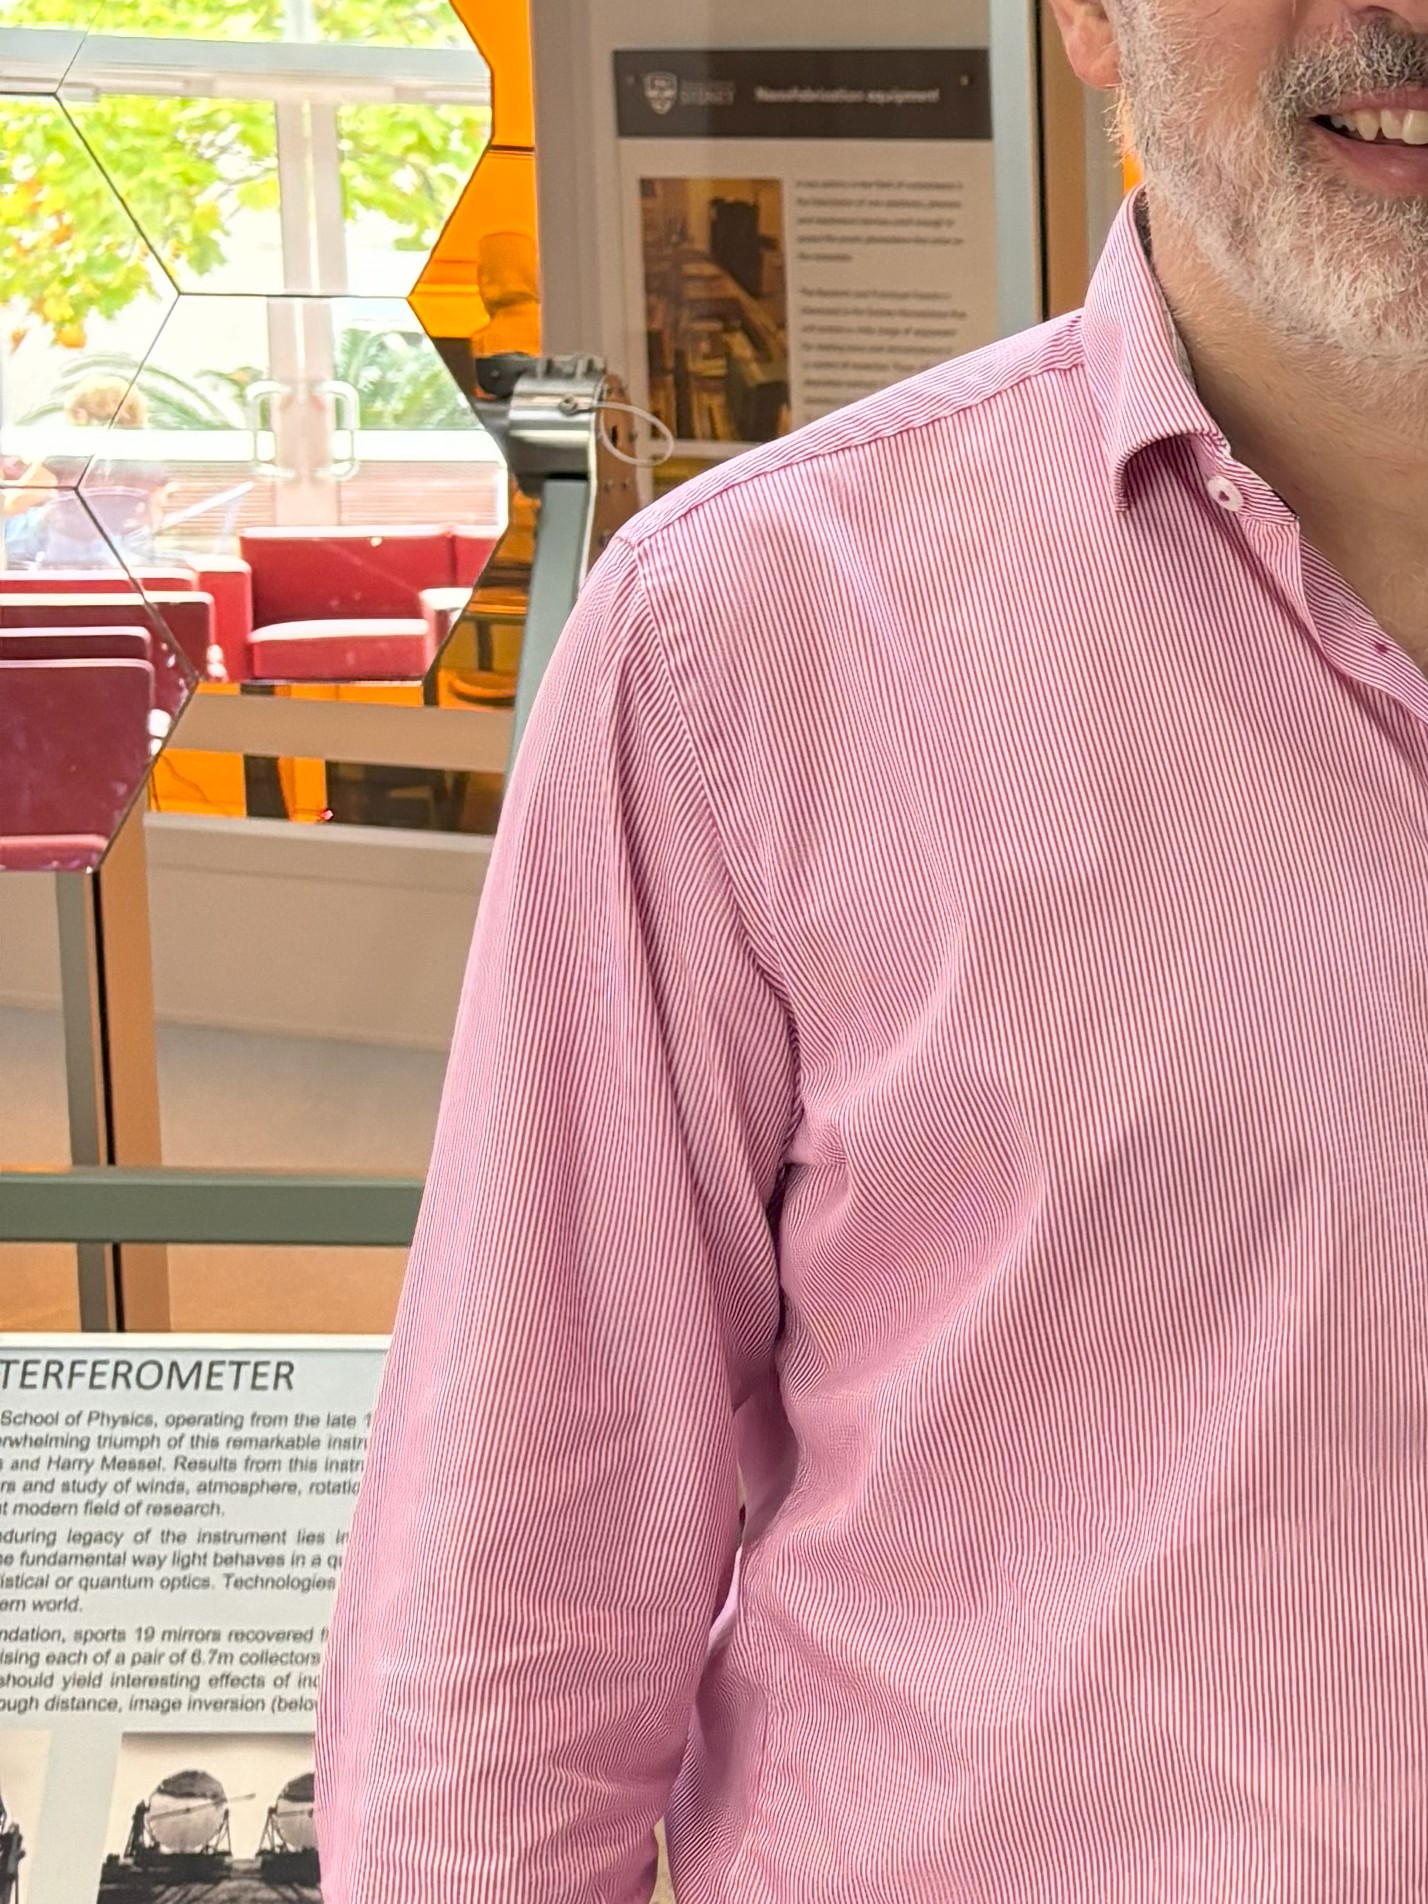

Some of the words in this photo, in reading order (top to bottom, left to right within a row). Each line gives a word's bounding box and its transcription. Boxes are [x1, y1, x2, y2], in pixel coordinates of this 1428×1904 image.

[0, 1359, 295, 1391] TERFEROMETER
[0, 1410, 60, 1426] School
[65, 1410, 83, 1426] of
[87, 1410, 158, 1432] Physics,
[164, 1411, 244, 1432] operating
[250, 1411, 288, 1428] from
[294, 1412, 321, 1428] the
[326, 1412, 357, 1428] late
[0, 1432, 91, 1454] rwhelming
[96, 1432, 161, 1454] triumph
[167, 1433, 186, 1449] of
[190, 1433, 220, 1449] this
[226, 1433, 321, 1450] remarkable
[10, 1455, 41, 1471] and
[47, 1455, 95, 1476] Harry
[100, 1456, 166, 1472] Messel.
[173, 1456, 237, 1472] Results
[244, 1457, 282, 1472] from
[288, 1457, 318, 1472] this
[22, 1478, 55, 1494] and
[60, 1478, 108, 1499] study
[113, 1478, 132, 1494] of
[136, 1478, 190, 1496] winds,
[196, 1479, 302, 1500] atmosphere,
[13, 1500, 78, 1516] modern
[83, 1500, 120, 1516] field
[124, 1500, 143, 1516] of
[145, 1500, 225, 1516] research.
[0, 1528, 57, 1549] during
[66, 1528, 124, 1549] legacy
[133, 1528, 152, 1544] of
[160, 1528, 187, 1544] the
[197, 1528, 287, 1544] instrument
[297, 1528, 325, 1544] lies
[20, 1550, 127, 1566] fundamental
[132, 1553, 168, 1571] way
[172, 1550, 207, 1572] light
[213, 1550, 285, 1567] behaves
[290, 1550, 306, 1567] in
[311, 1553, 321, 1567] a
[55, 1577, 74, 1589] or
[78, 1573, 154, 1594] quantum
[160, 1573, 215, 1595] optics.
[223, 1573, 336, 1595] Technologies
[32, 1596, 83, 1612] world.
[73, 1626, 127, 1647] sports
[134, 1626, 155, 1642] 19
[161, 1626, 221, 1642] mirrors
[228, 1626, 313, 1642] recovered
[45, 1648, 87, 1665] each
[92, 1648, 111, 1665] of
[115, 1652, 126, 1665] a
[131, 1648, 164, 1670] pair
[168, 1649, 187, 1665] of
[191, 1649, 234, 1665] 6.7m
[61, 1672, 103, 1693] yield
[110, 1672, 200, 1693] interesting
[208, 1672, 266, 1688] effects
[273, 1672, 291, 1688] of
[44, 1695, 123, 1713] distance,
[129, 1695, 182, 1716] image
[188, 1696, 266, 1711] inversion
[271, 1696, 317, 1716] (belo
